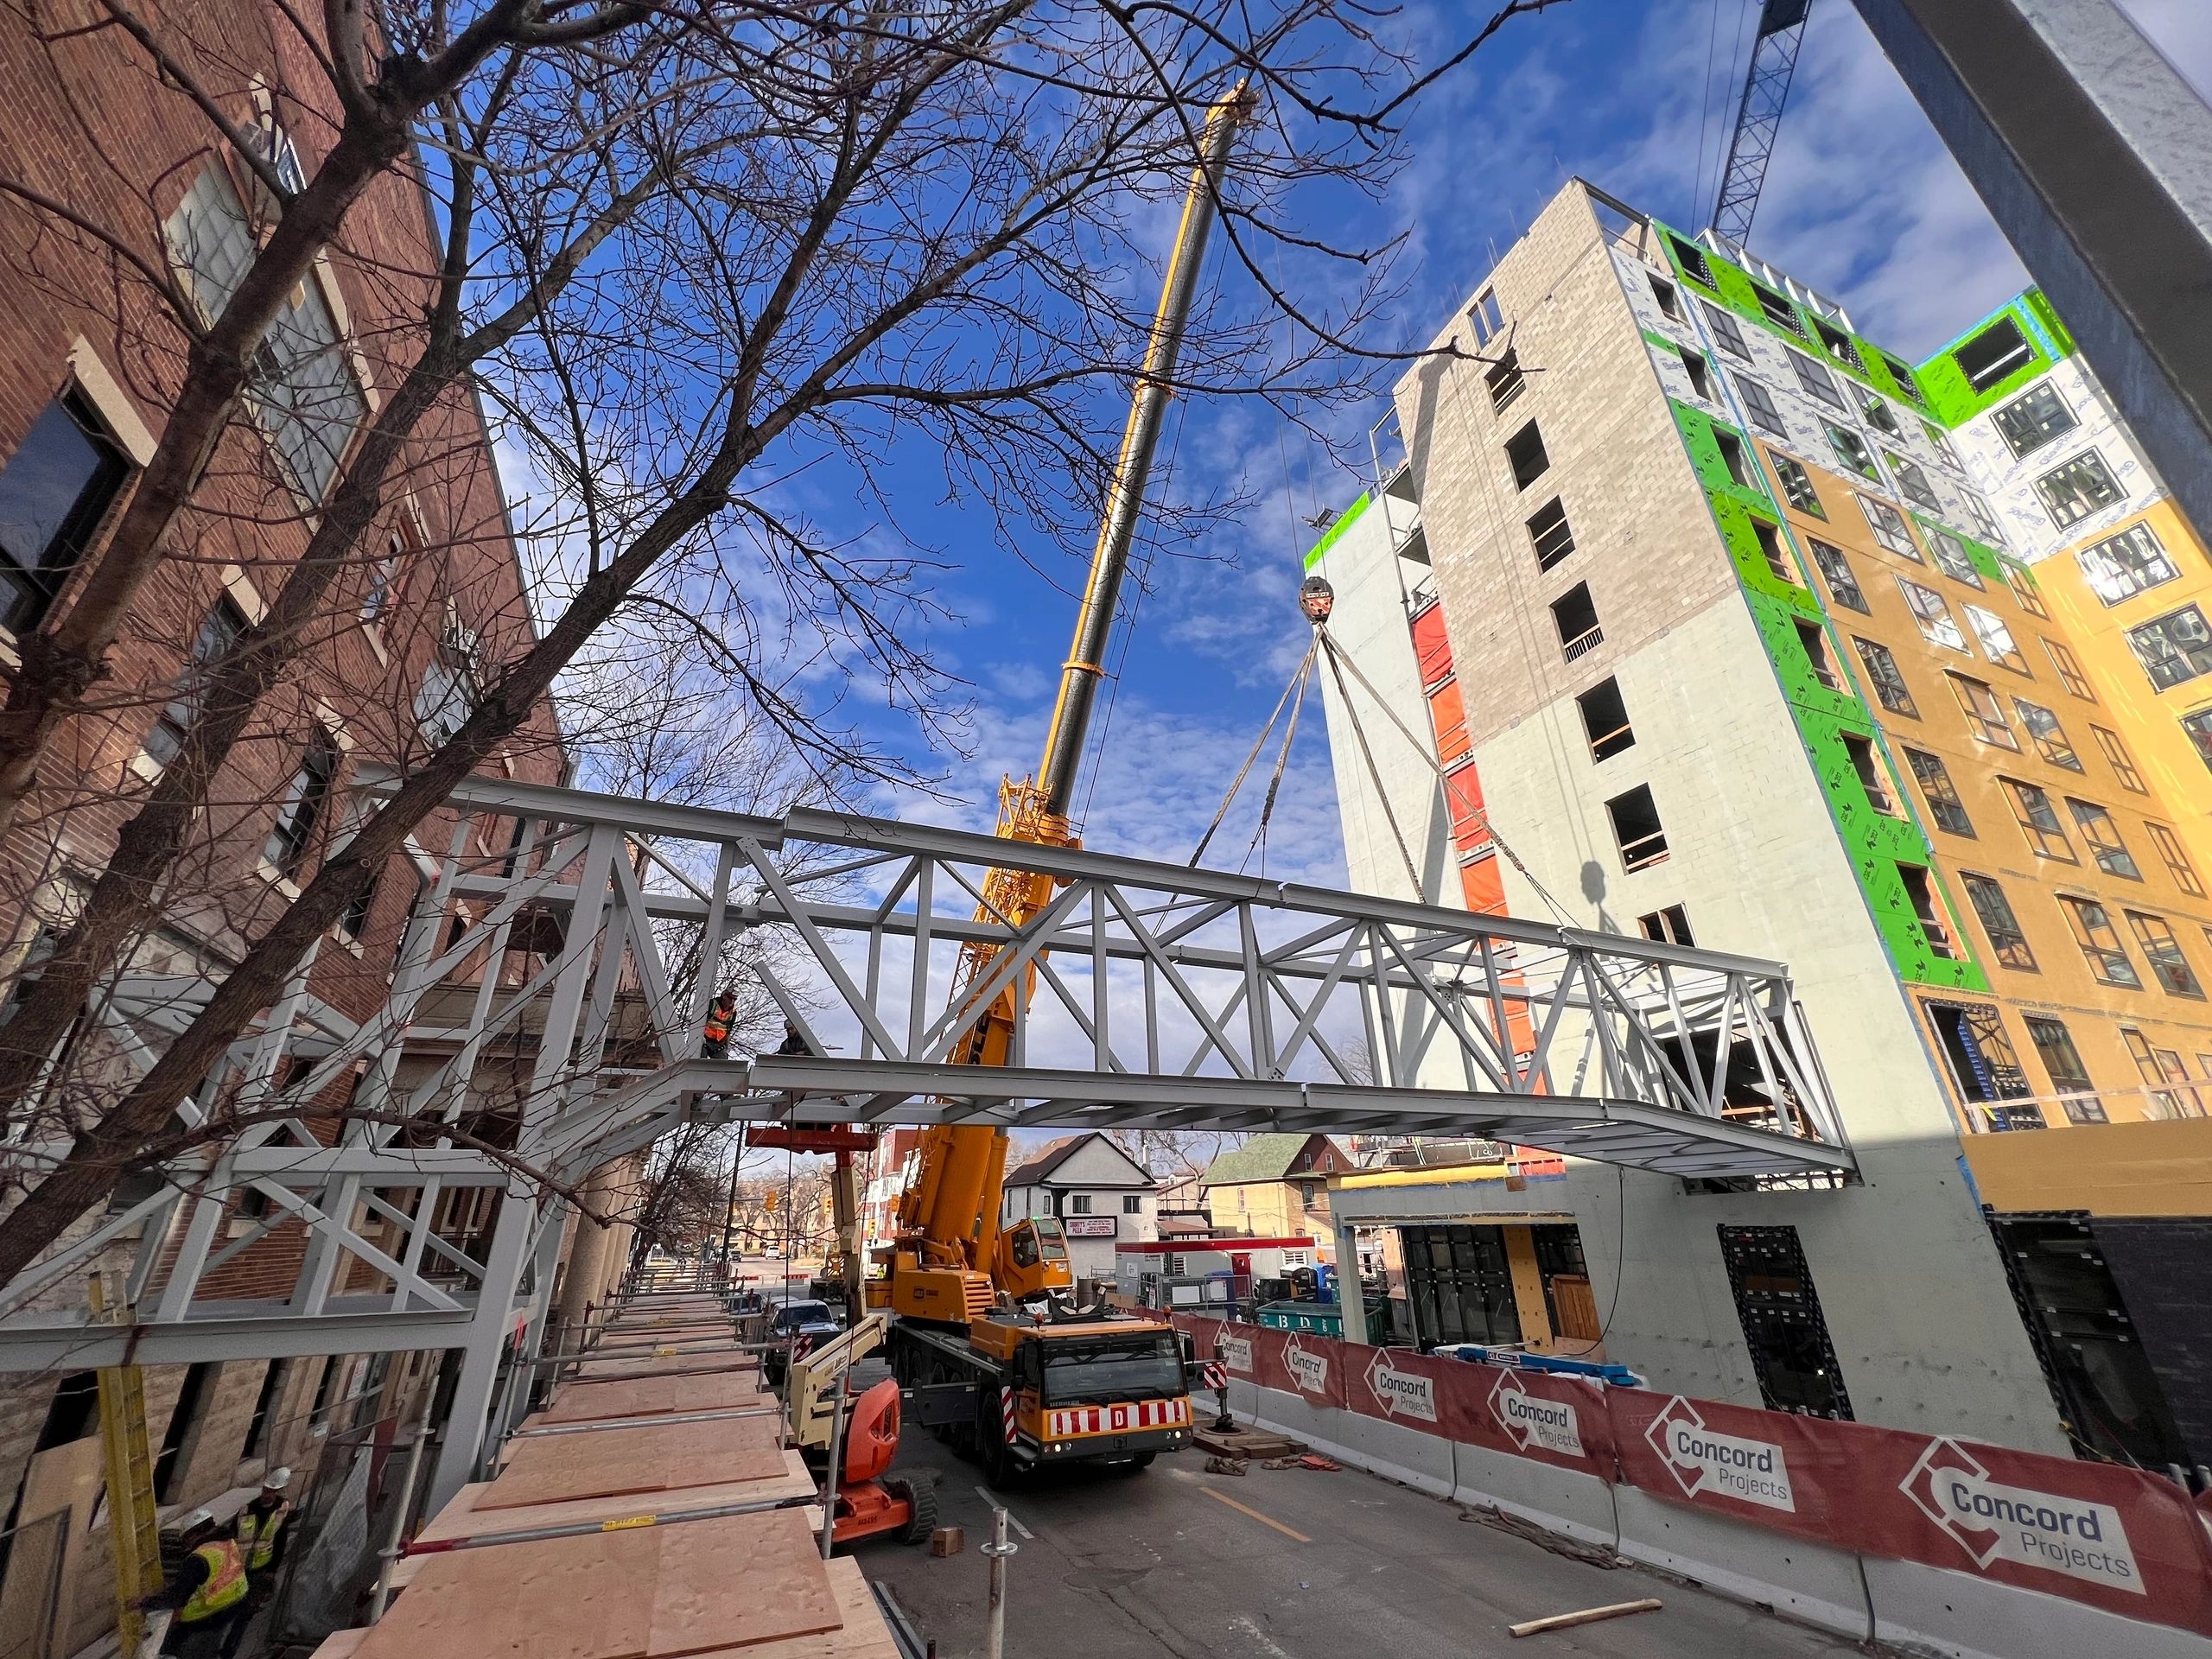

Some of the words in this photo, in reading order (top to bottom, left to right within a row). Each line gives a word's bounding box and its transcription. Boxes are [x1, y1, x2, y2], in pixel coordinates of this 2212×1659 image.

[1380, 1372, 1427, 1397] Concord
[1401, 1395, 1433, 1415] Projects
[1508, 1397, 1568, 1428] Concord
[1538, 1426, 1580, 1448] Projects
[1677, 1431, 1774, 1474] Concord
[1719, 1468, 1788, 1500] Projects
[1951, 1482, 2103, 1542] Concord
[2020, 1531, 2132, 1578] Projects
